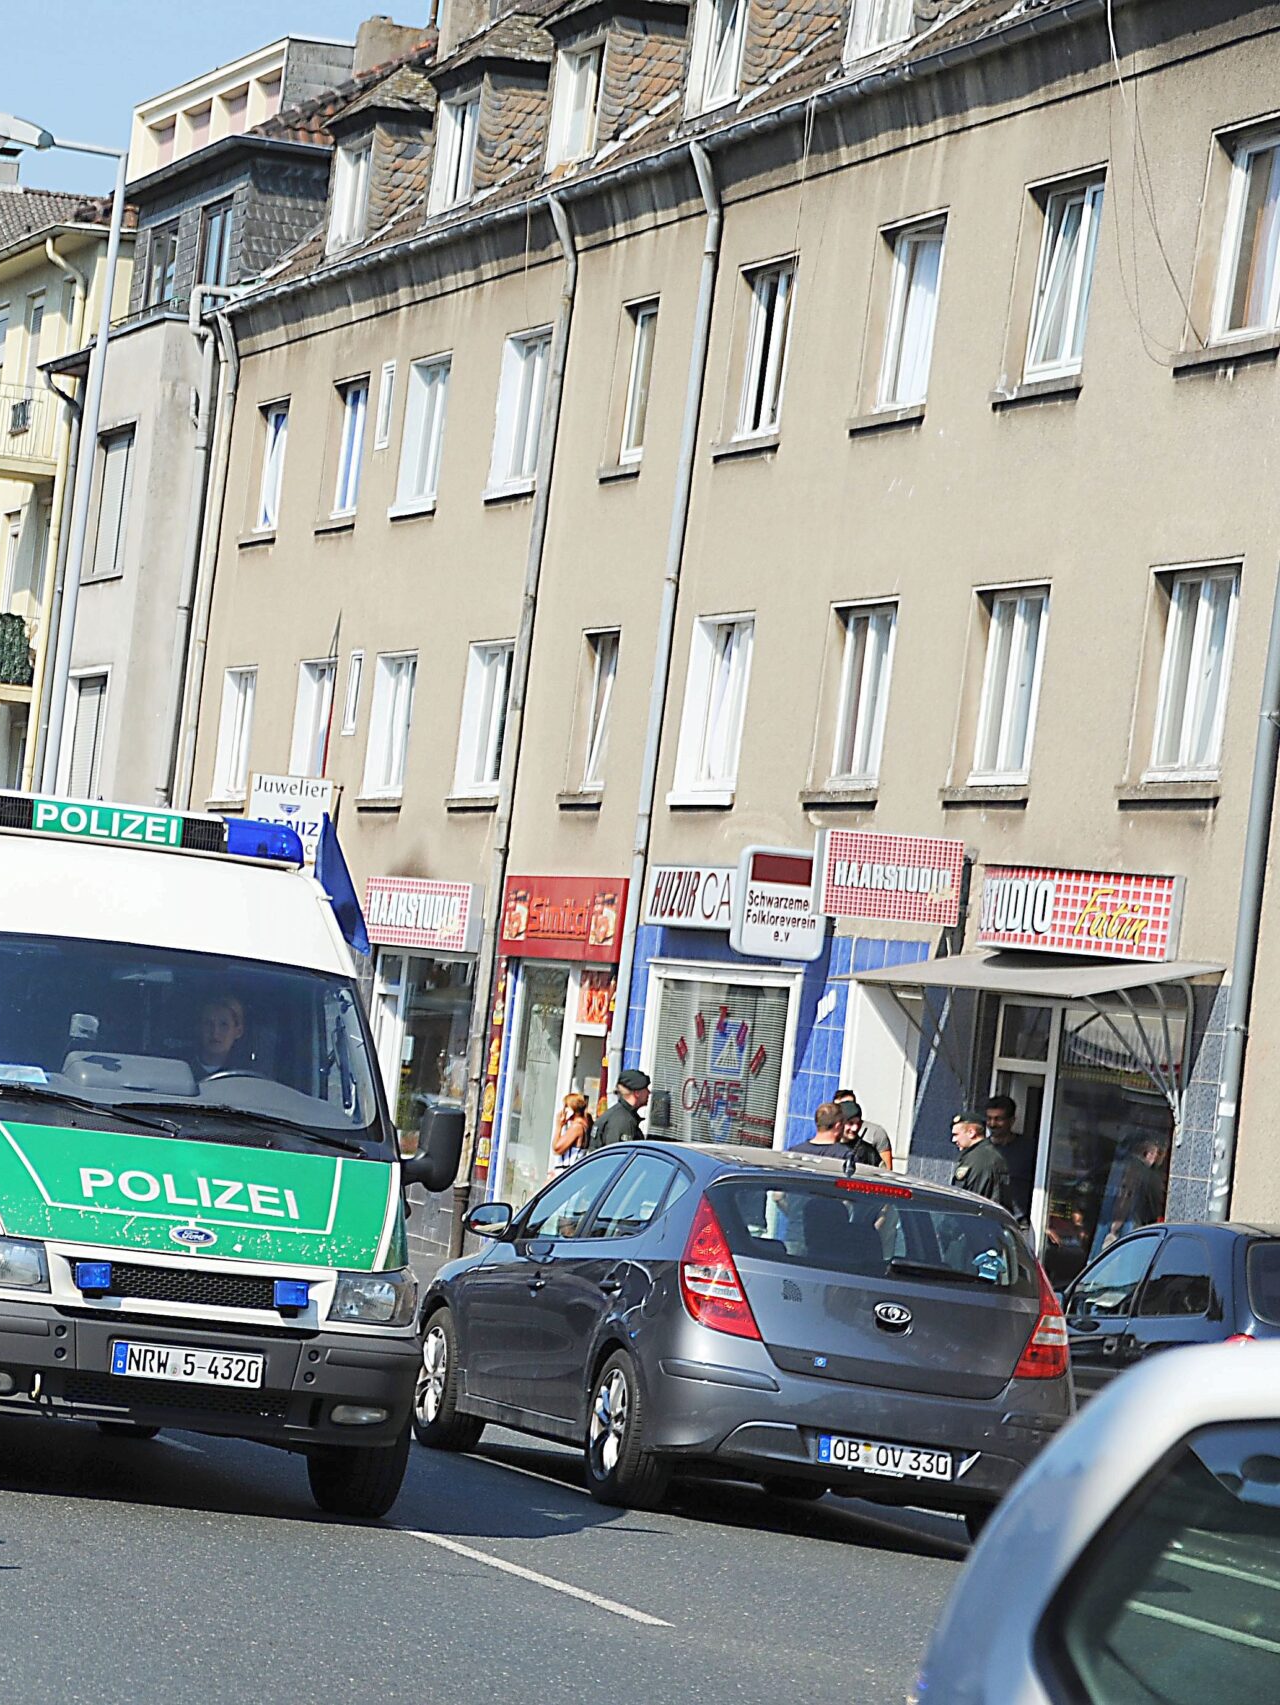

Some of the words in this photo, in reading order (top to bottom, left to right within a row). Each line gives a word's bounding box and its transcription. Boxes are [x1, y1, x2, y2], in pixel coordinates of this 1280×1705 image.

[254, 775, 329, 798] Juwelier
[36, 803, 178, 844] POLIZEI
[257, 816, 319, 838] NIZ
[649, 870, 701, 919] HUZUR
[833, 860, 952, 895] HAARSTUDIO
[367, 889, 461, 931] HAARSTUDIO
[745, 908, 817, 930] Folkloreverein
[1073, 888, 1150, 946] Fatin
[681, 1077, 741, 1117] CAFE
[79, 1167, 300, 1220] POLIZEI
[180, 1229, 207, 1243] Ford
[128, 1347, 170, 1375] NRW
[182, 1353, 260, 1384] 5-4320
[833, 1439, 860, 1462] OB
[876, 1445, 904, 1469] OV
[908, 1449, 949, 1476] 330
